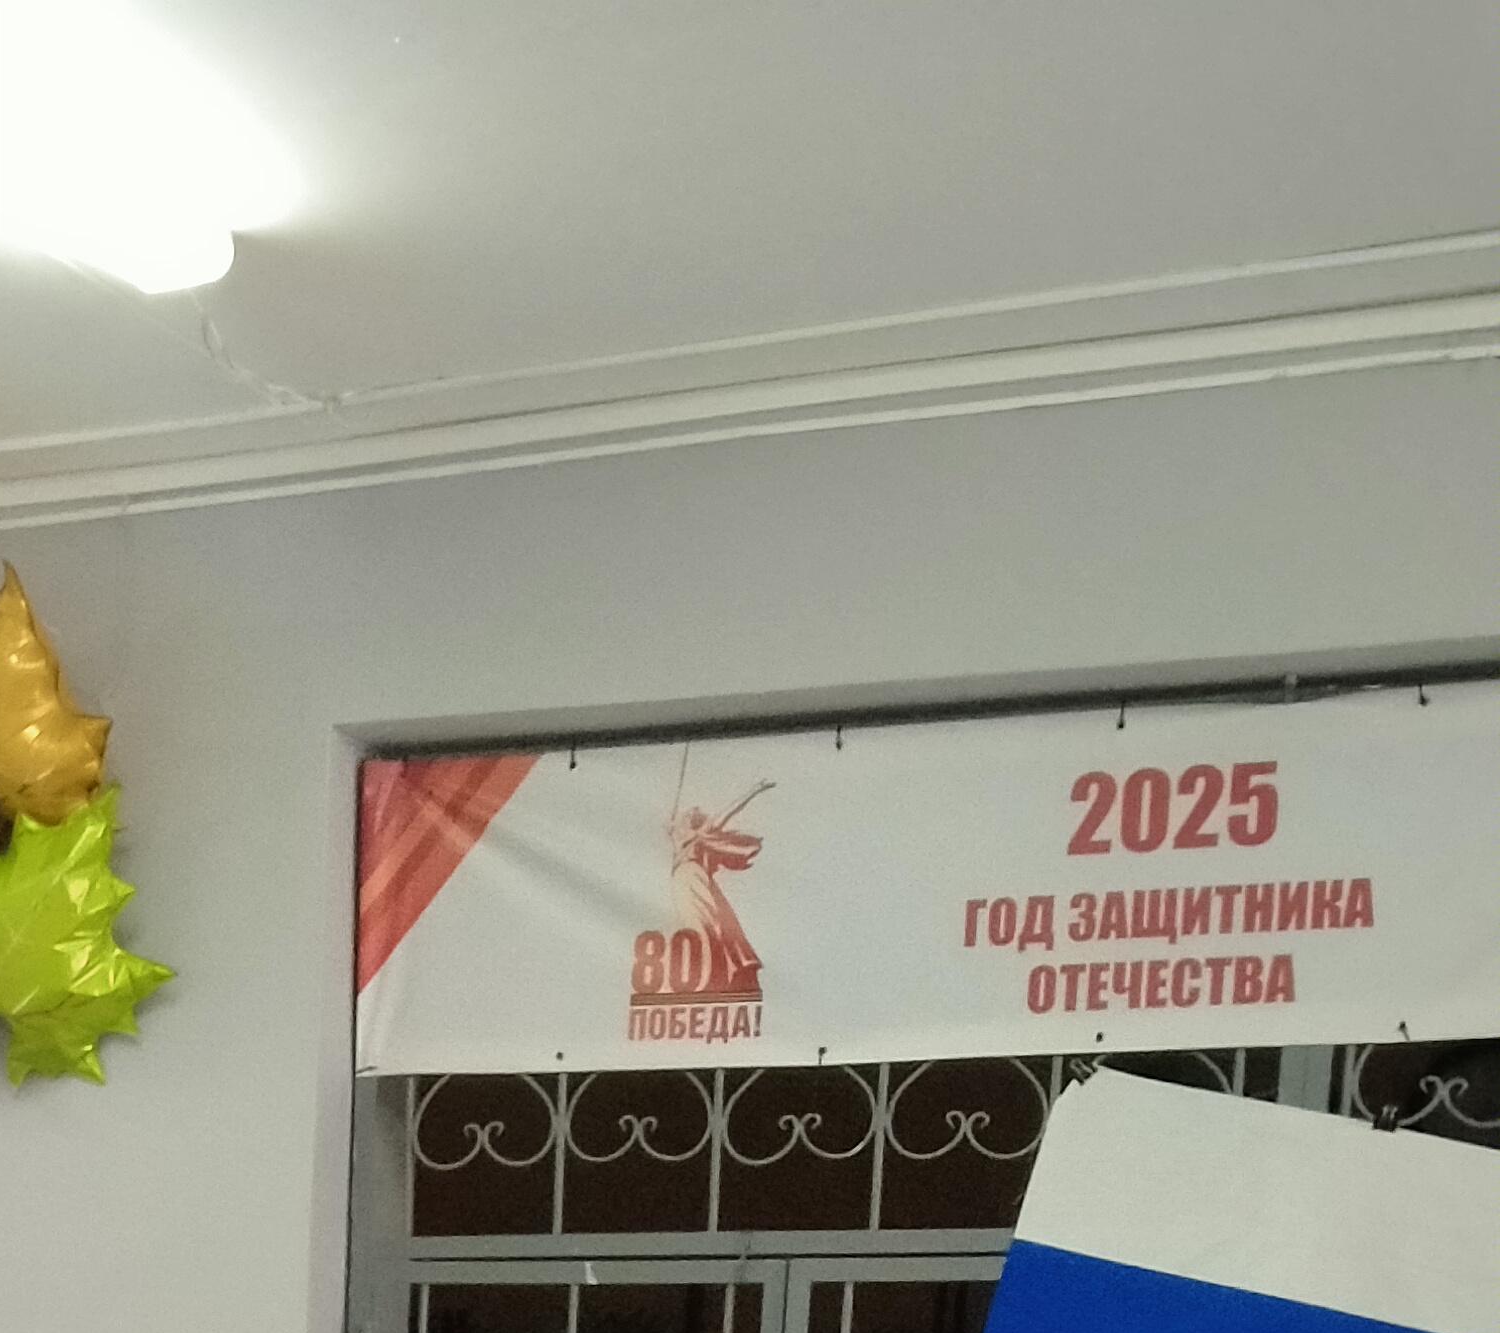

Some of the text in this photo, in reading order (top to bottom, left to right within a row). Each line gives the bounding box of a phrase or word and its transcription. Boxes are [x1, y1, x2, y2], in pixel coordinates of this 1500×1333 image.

[1067, 761, 1279, 855] 2025
[964, 878, 1374, 952] ГОД ЗАЩИТНИКА
[631, 928, 703, 994] 80
[1027, 954, 1296, 1014] ОТЕЧЕСТВА
[628, 1005, 762, 1044] ПОБЕДА!
